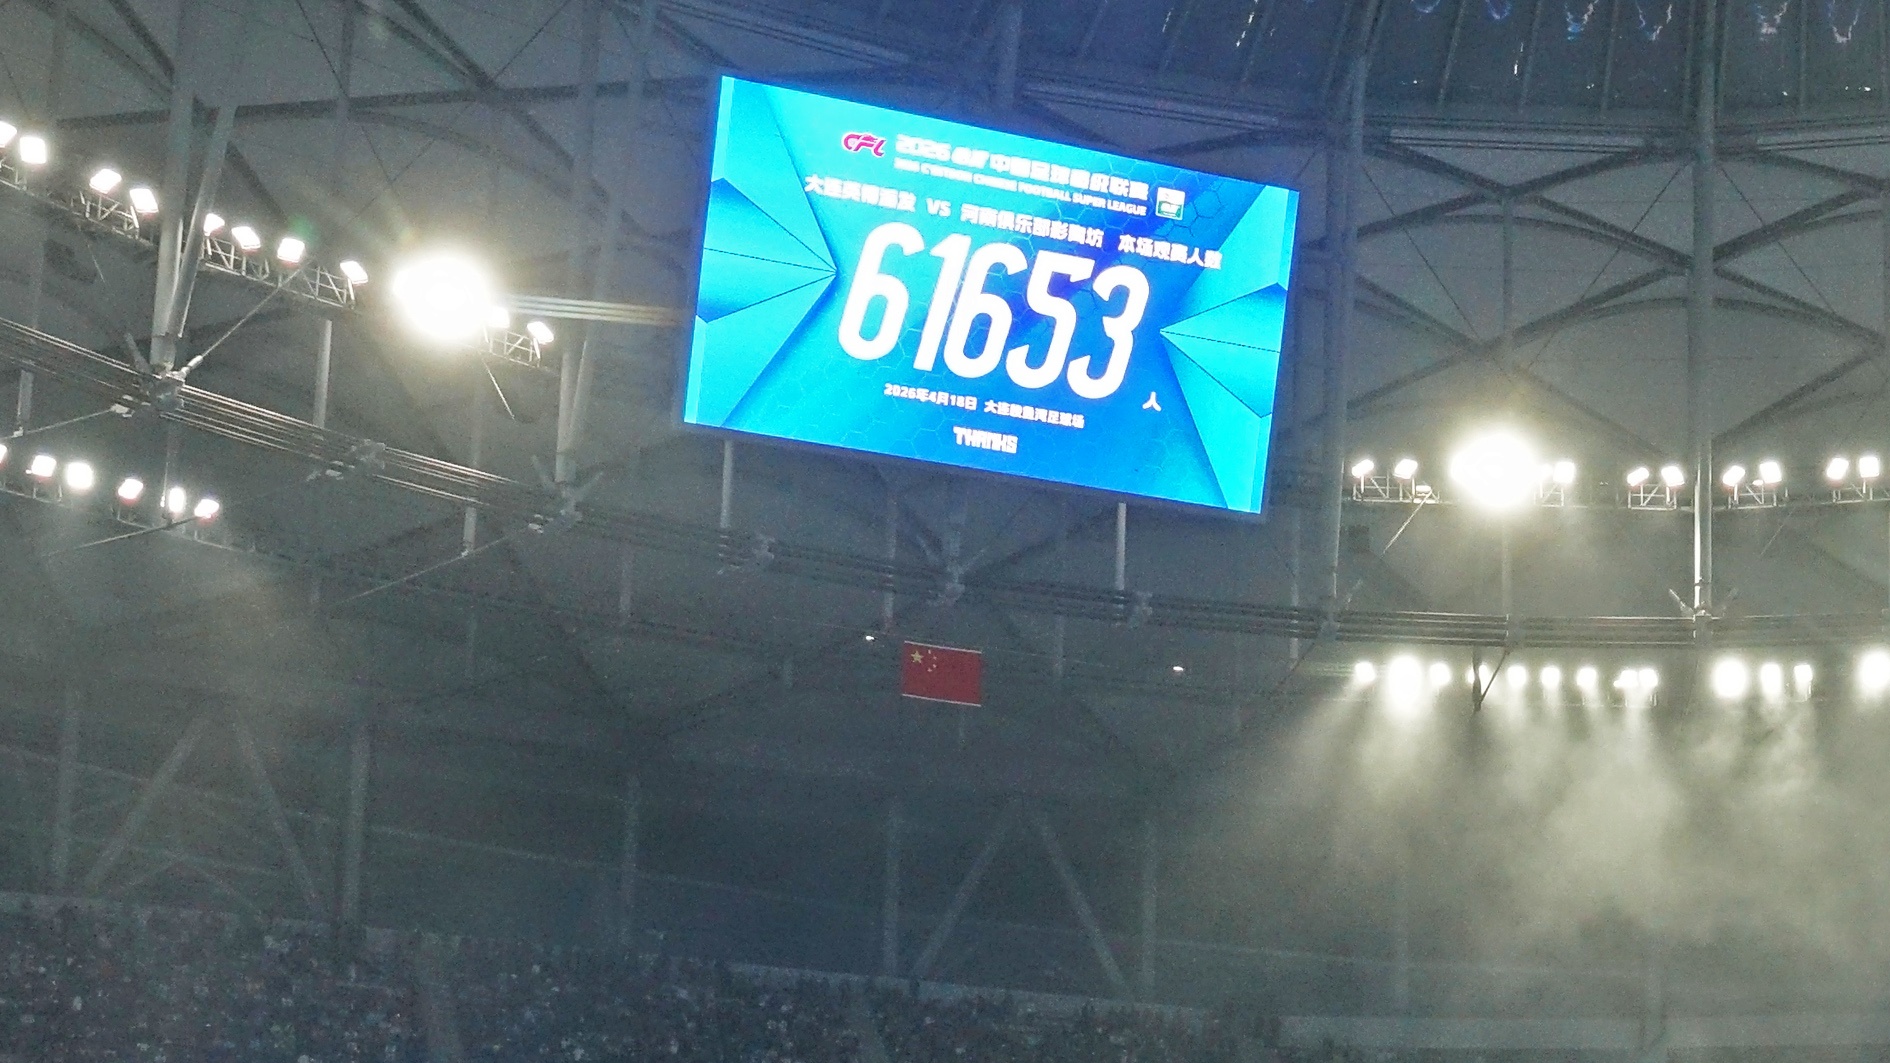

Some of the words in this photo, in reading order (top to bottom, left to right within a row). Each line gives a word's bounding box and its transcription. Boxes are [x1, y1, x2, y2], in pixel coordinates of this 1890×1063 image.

[927, 198, 951, 217] VS
[1106, 199, 1147, 216] LEAGUE
[836, 221, 1151, 400] 61653
[1142, 391, 1162, 412] 人
[883, 383, 978, 411] 2026年4月18日
